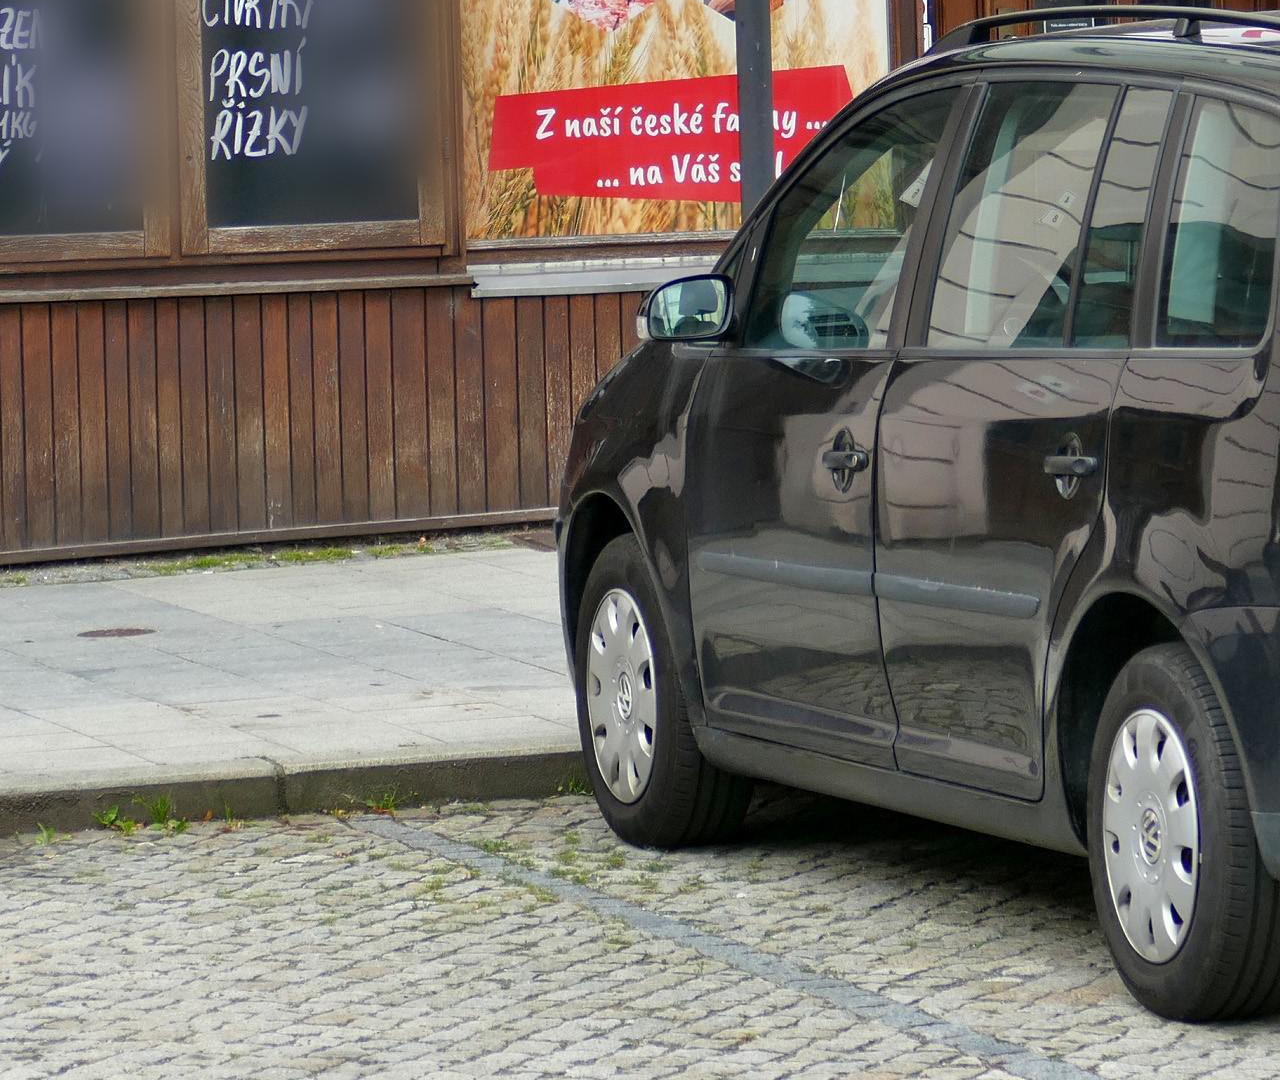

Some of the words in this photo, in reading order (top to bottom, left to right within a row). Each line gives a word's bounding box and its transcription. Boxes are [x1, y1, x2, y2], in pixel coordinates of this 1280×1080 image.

[209, 36, 307, 102] PRSNÍ
[209, 97, 309, 161] ŘÍZKY
[535, 107, 555, 140] Z
[564, 105, 623, 138] naší
[630, 102, 704, 137] české
[712, 102, 798, 139] fay
[629, 164, 661, 187] na
[671, 153, 720, 184] Váš
